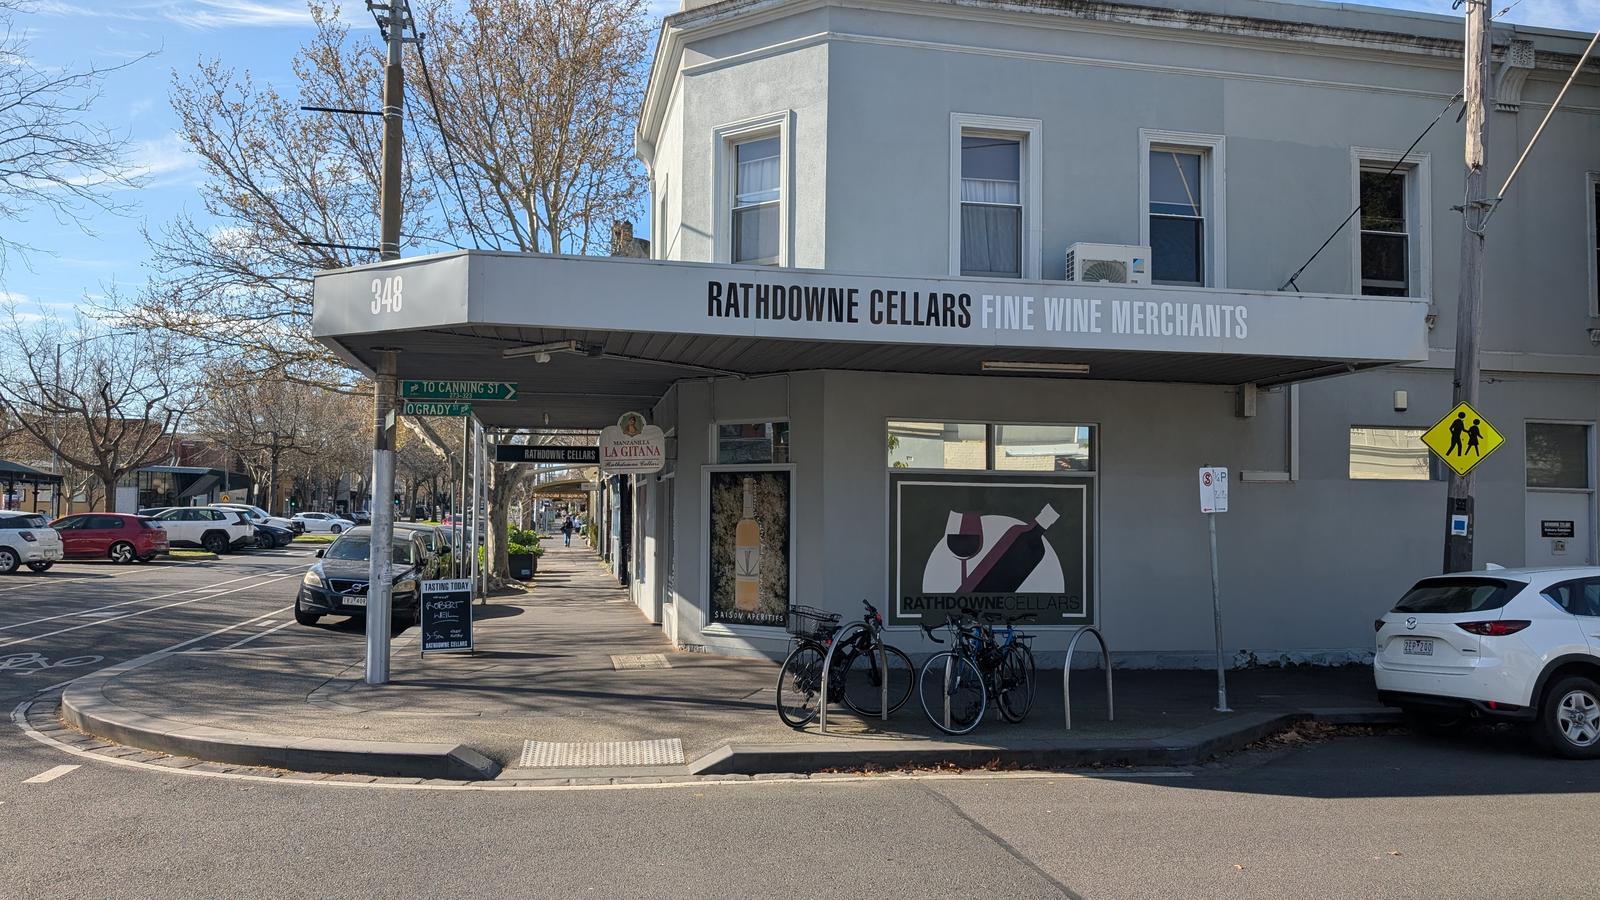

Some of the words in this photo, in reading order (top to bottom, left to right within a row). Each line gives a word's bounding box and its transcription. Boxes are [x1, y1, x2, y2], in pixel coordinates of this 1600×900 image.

[371, 275, 403, 315] 348
[707, 280, 859, 324] RATHDOWNE
[869, 289, 972, 329] CELLARS
[981, 294, 1035, 331] FINE
[1043, 296, 1102, 334] WINE
[1111, 300, 1249, 340] MERCHANTS
[422, 382, 436, 393] TO
[439, 382, 484, 394] CANNING
[487, 383, 499, 394] ST
[406, 403, 451, 415] O'GRADY
[524, 449, 566, 460] RATHDOWNE
[567, 450, 596, 461] CELLARS
[603, 446, 618, 458] LA
[620, 445, 661, 457] GITANA
[425, 583, 449, 591] TASTING
[451, 582, 469, 590] TODAY
[714, 610, 744, 620] SAISON
[746, 612, 784, 622] APERITIFS
